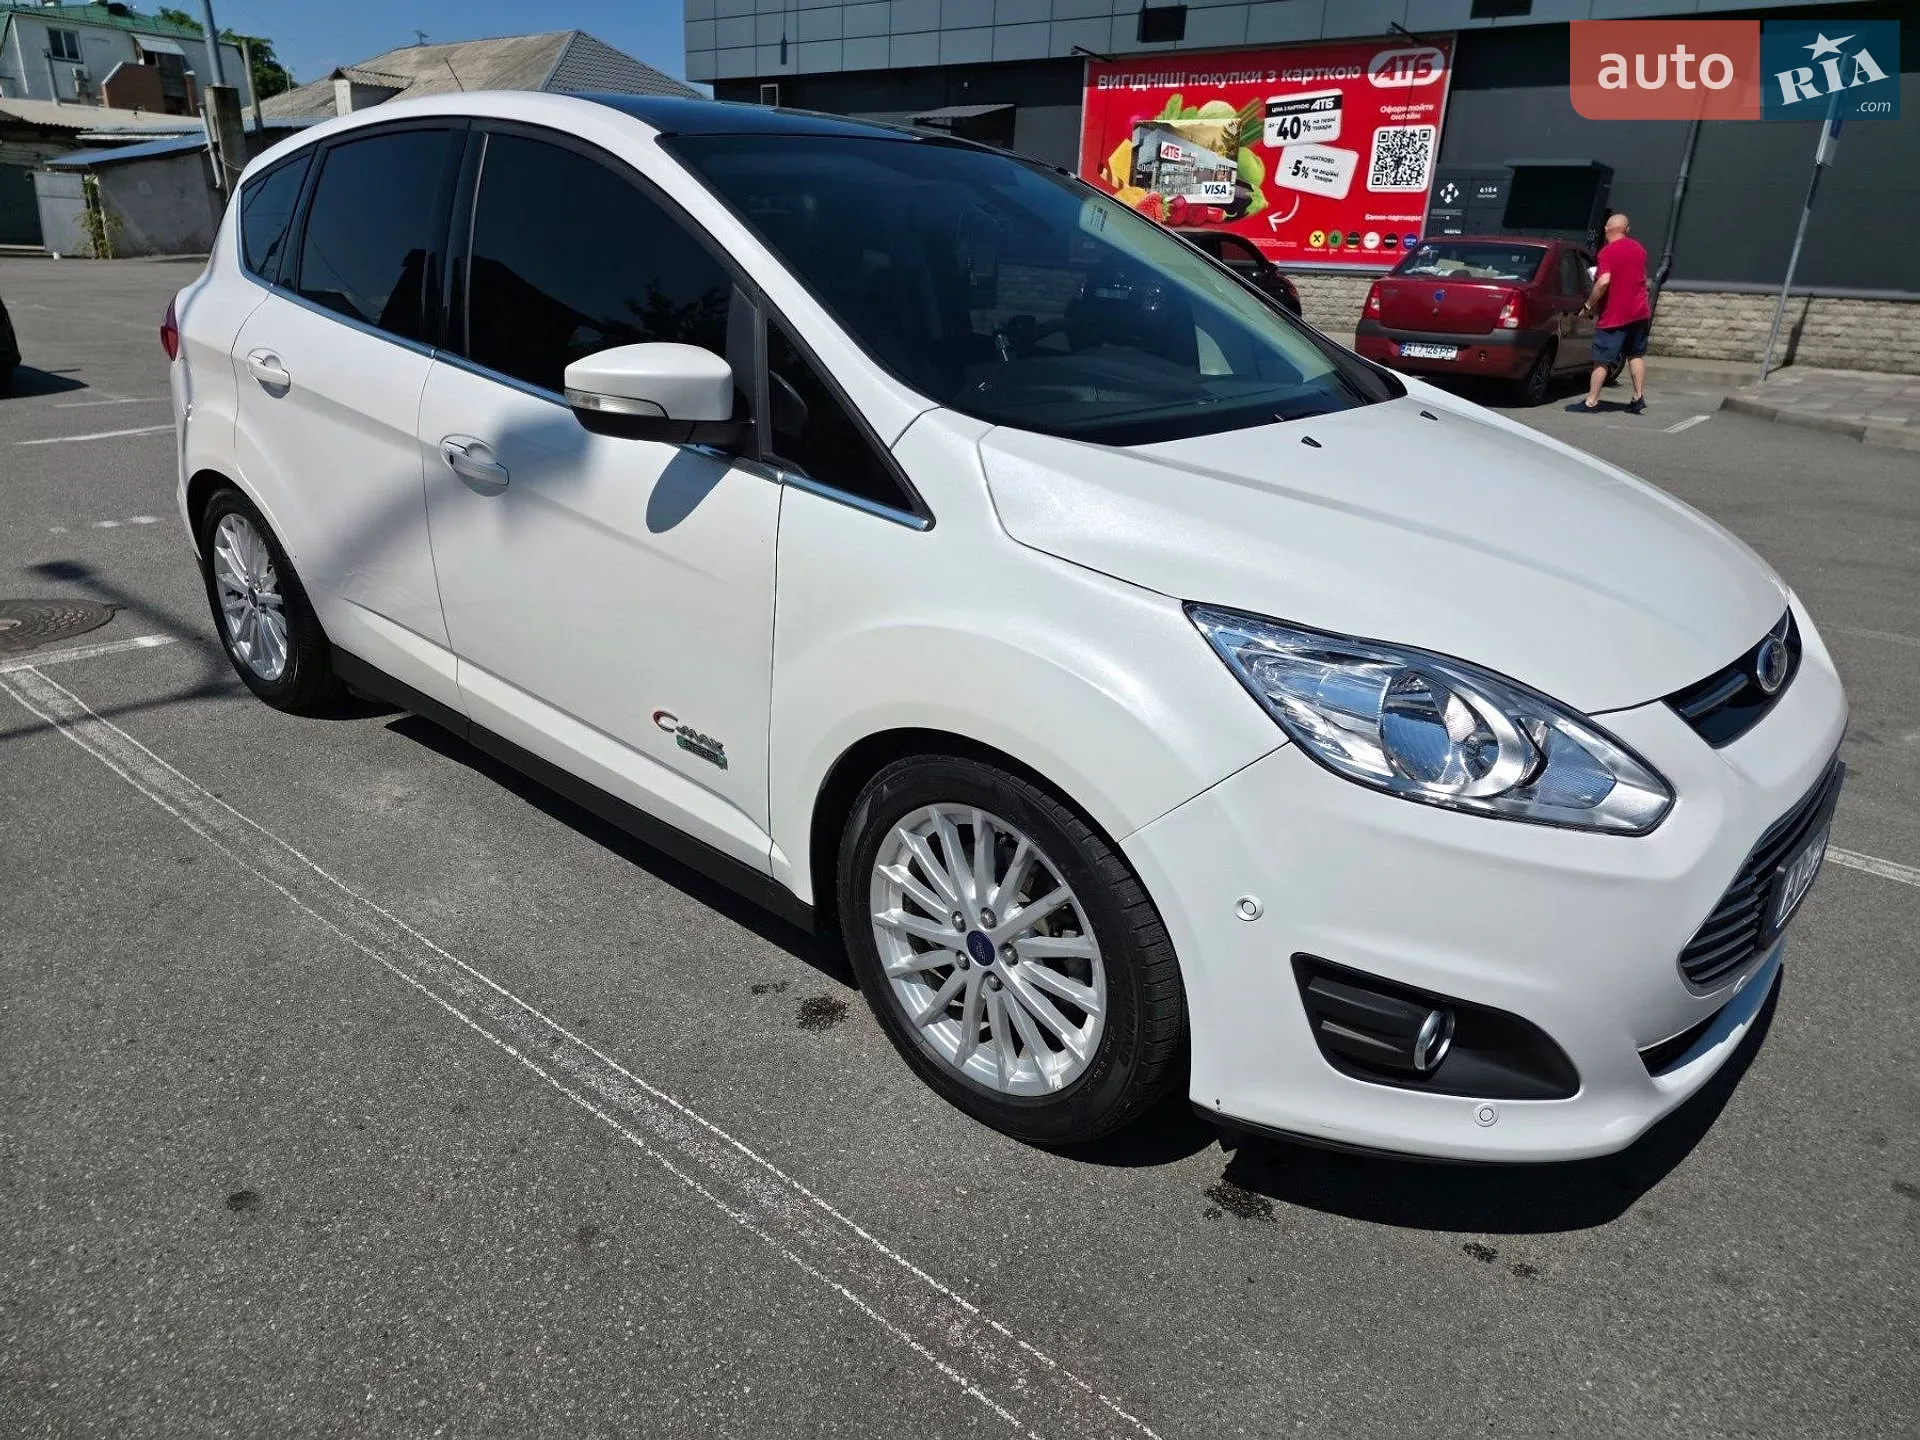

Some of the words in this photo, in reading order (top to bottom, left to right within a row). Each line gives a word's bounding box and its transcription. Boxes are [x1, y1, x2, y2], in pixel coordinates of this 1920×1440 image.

[1374, 53, 1437, 81] АТБ
[1097, 71, 1186, 92] ВИГІДНІШІ
[1189, 70, 1262, 88] покупки
[1266, 69, 1277, 83] з
[1281, 65, 1361, 85] карткою
[1310, 97, 1335, 110] АТБ
[1162, 145, 1180, 159] АТБ
[1204, 184, 1228, 195] VISA
